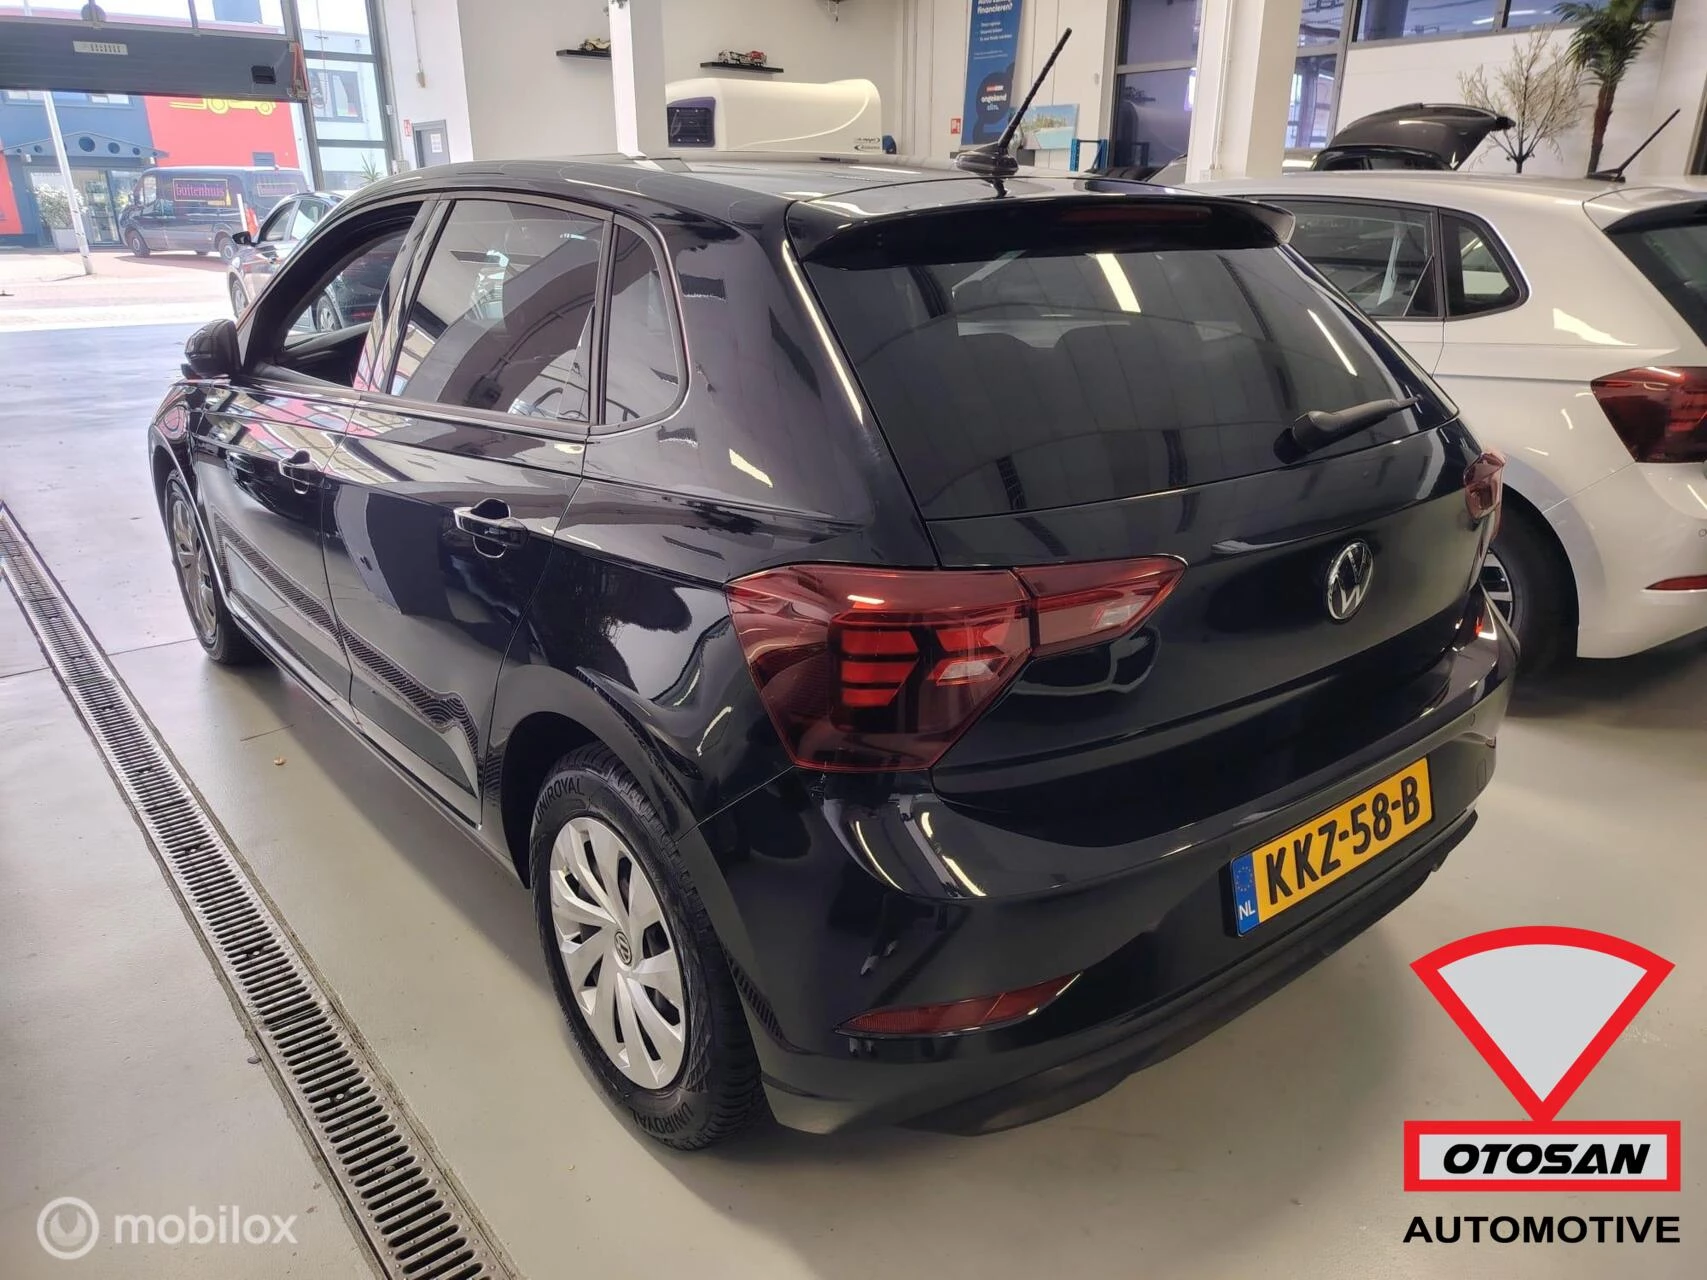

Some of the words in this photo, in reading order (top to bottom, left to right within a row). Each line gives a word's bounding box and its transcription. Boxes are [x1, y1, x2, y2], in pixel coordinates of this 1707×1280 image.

[977, 3, 1013, 14] financieren?
[535, 776, 585, 824] UNIROYAL
[1266, 776, 1420, 905] KKZ-58-B
[1238, 900, 1256, 920] NL
